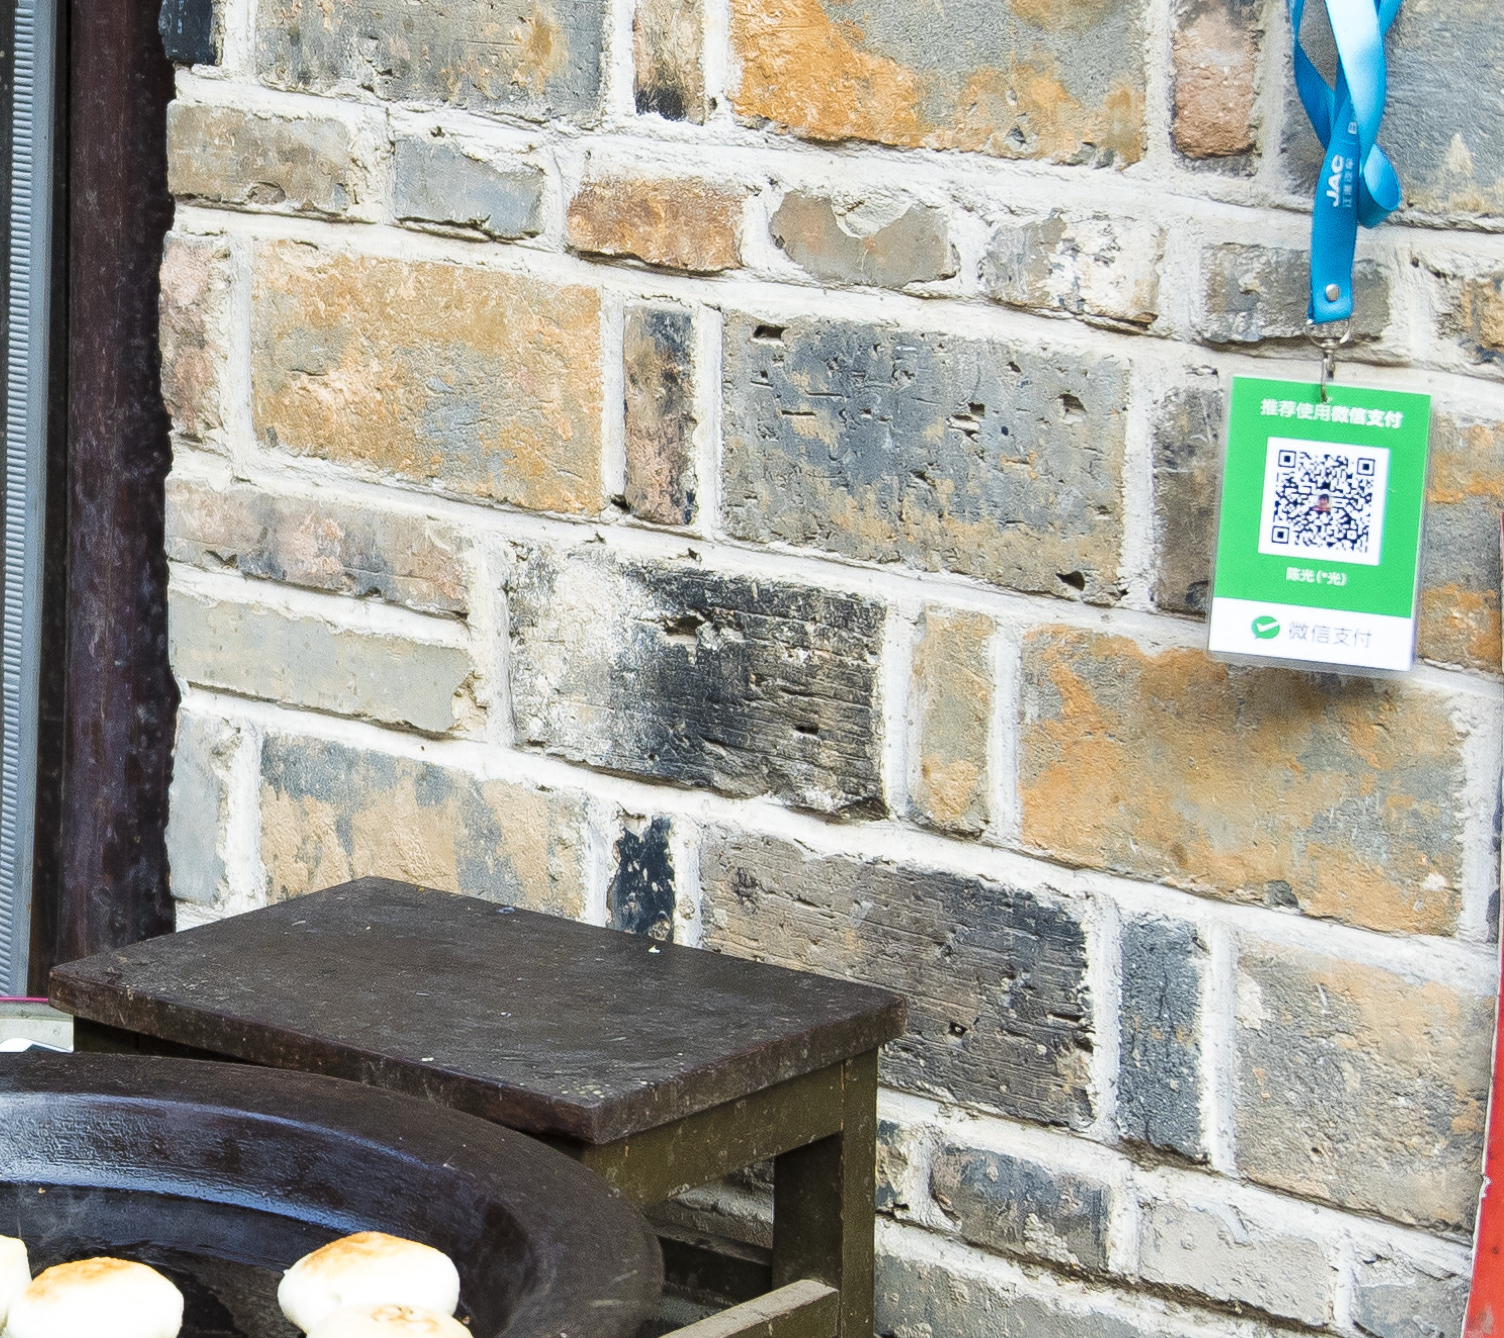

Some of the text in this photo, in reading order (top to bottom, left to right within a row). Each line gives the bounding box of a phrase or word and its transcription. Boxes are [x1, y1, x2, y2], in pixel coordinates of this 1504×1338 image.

[1326, 154, 1345, 208] JAC
[1260, 397, 1404, 429] 推荐使用微信支付
[1288, 621, 1372, 648] 微信支付
